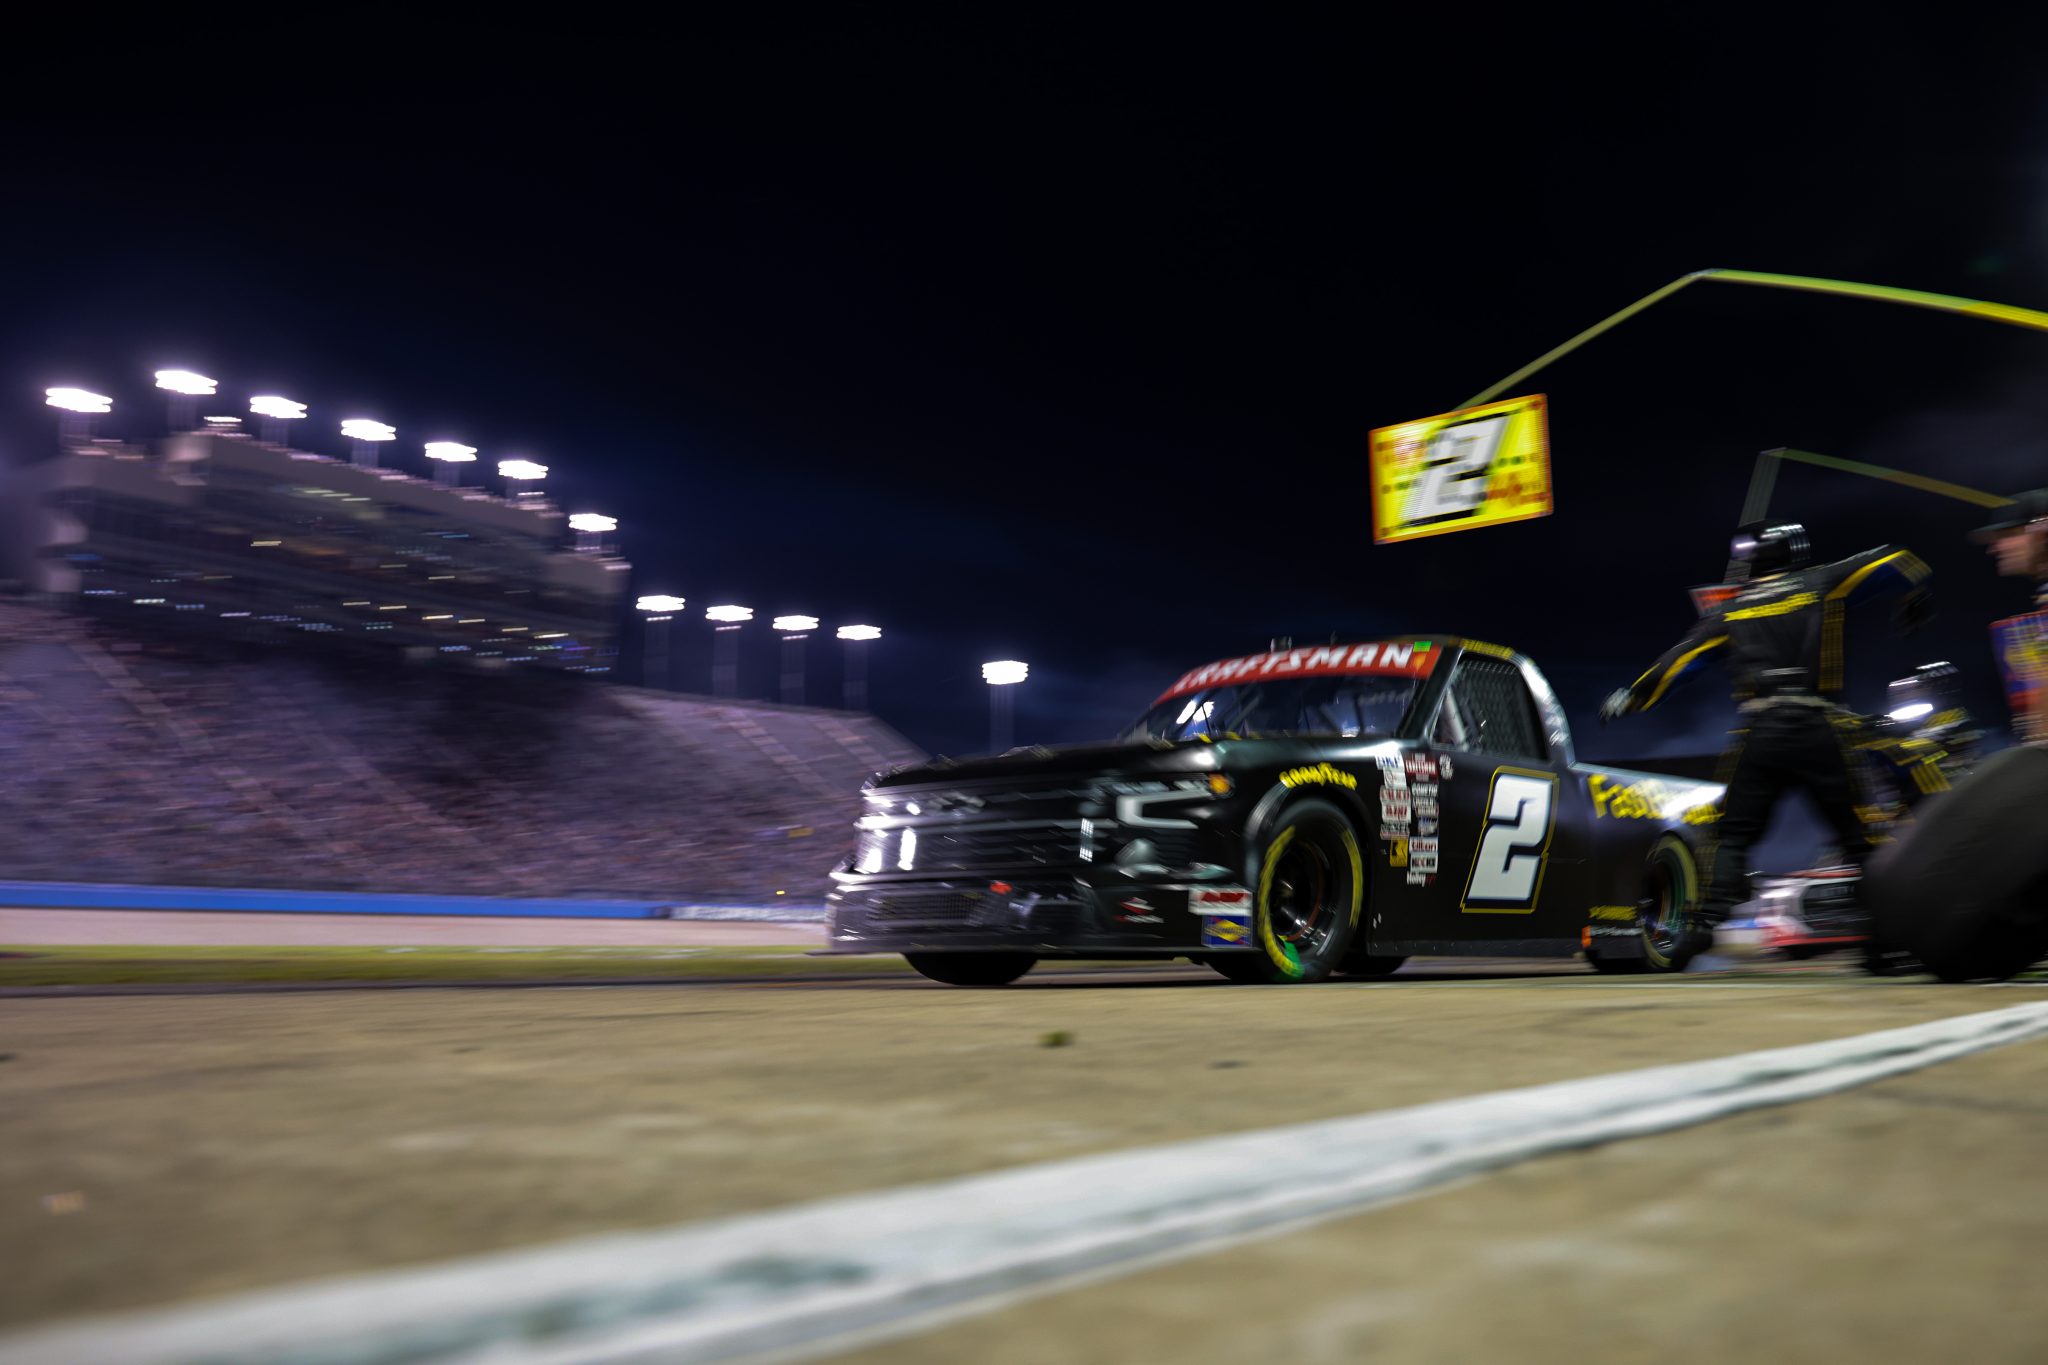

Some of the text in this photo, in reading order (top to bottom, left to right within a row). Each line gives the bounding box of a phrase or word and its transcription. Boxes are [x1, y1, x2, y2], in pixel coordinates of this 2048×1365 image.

[1172, 641, 1414, 694] CRAFTSMAN
[1279, 761, 1357, 791] GOODYEAR
[1466, 773, 1554, 901] 2
